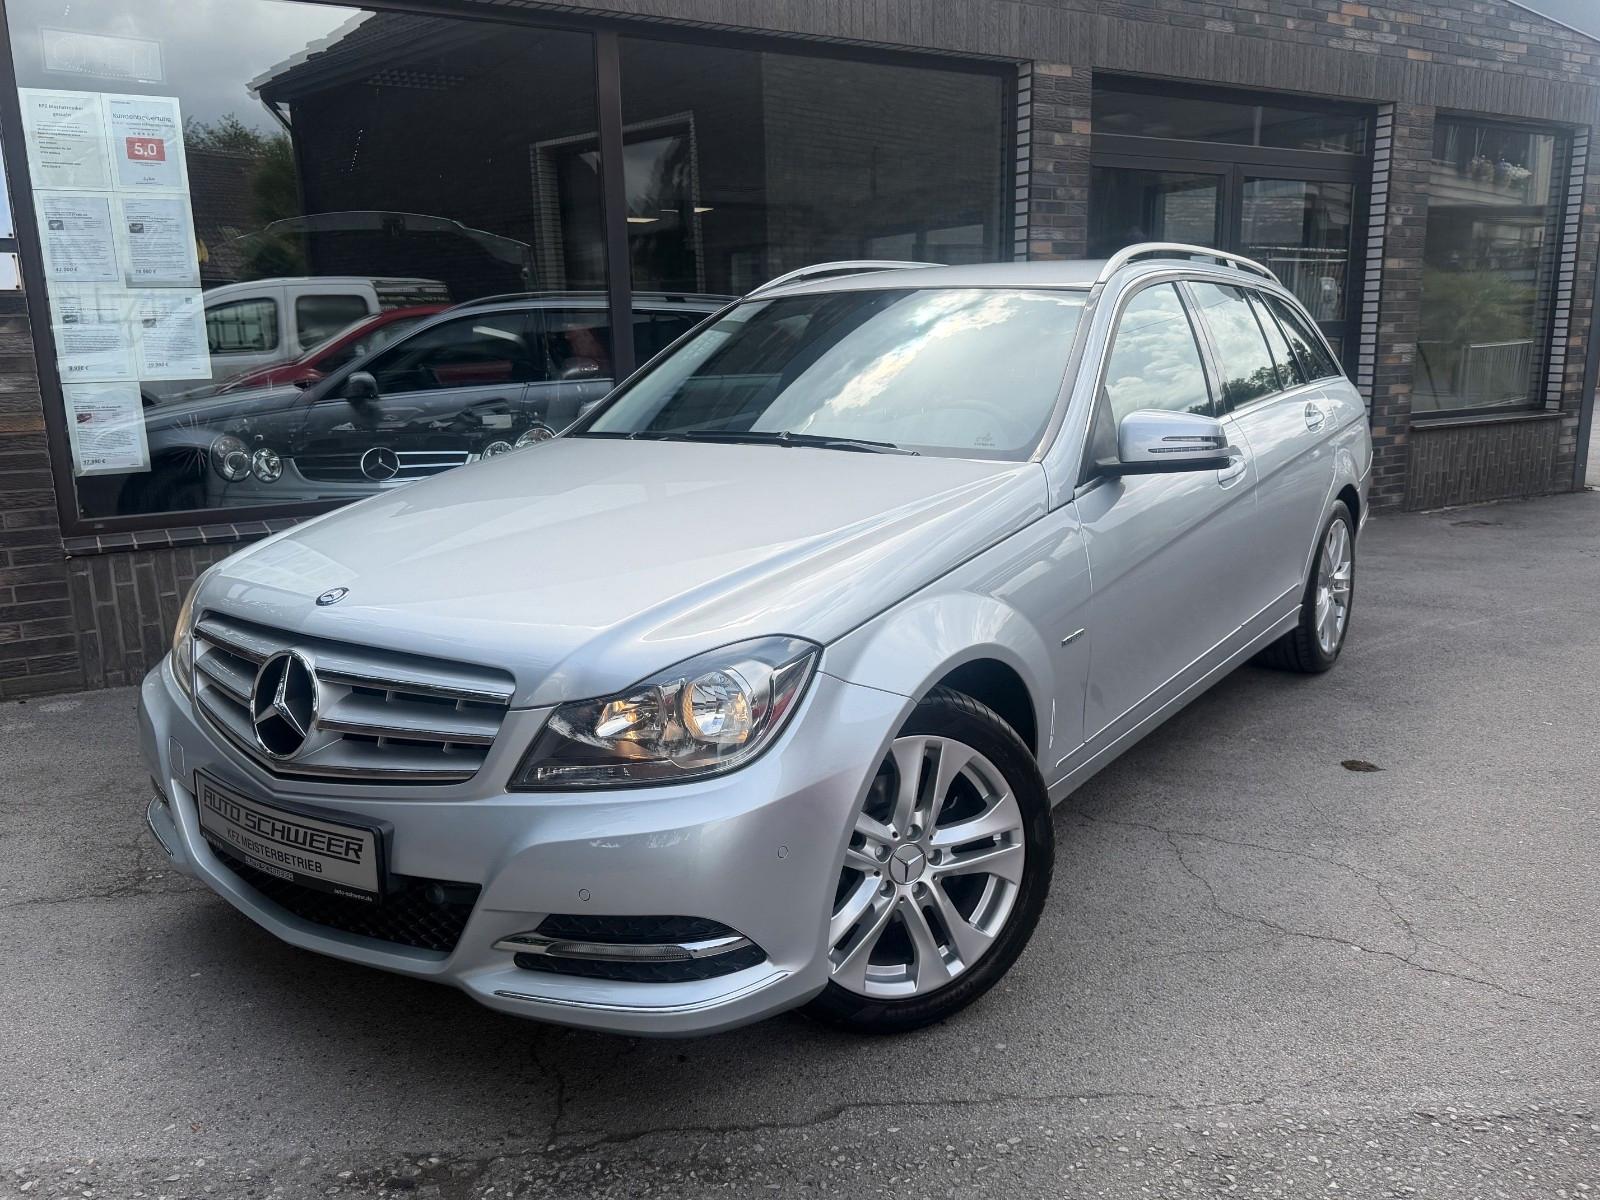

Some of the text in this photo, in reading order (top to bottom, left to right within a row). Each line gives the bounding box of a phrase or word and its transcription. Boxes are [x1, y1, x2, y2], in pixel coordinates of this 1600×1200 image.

[134, 143, 157, 157] 5,0
[203, 788, 241, 822] AUTO
[244, 813, 363, 860] SCHWEER
[226, 828, 241, 844] KFZ
[241, 836, 323, 873] MEISTERBETRIEB
